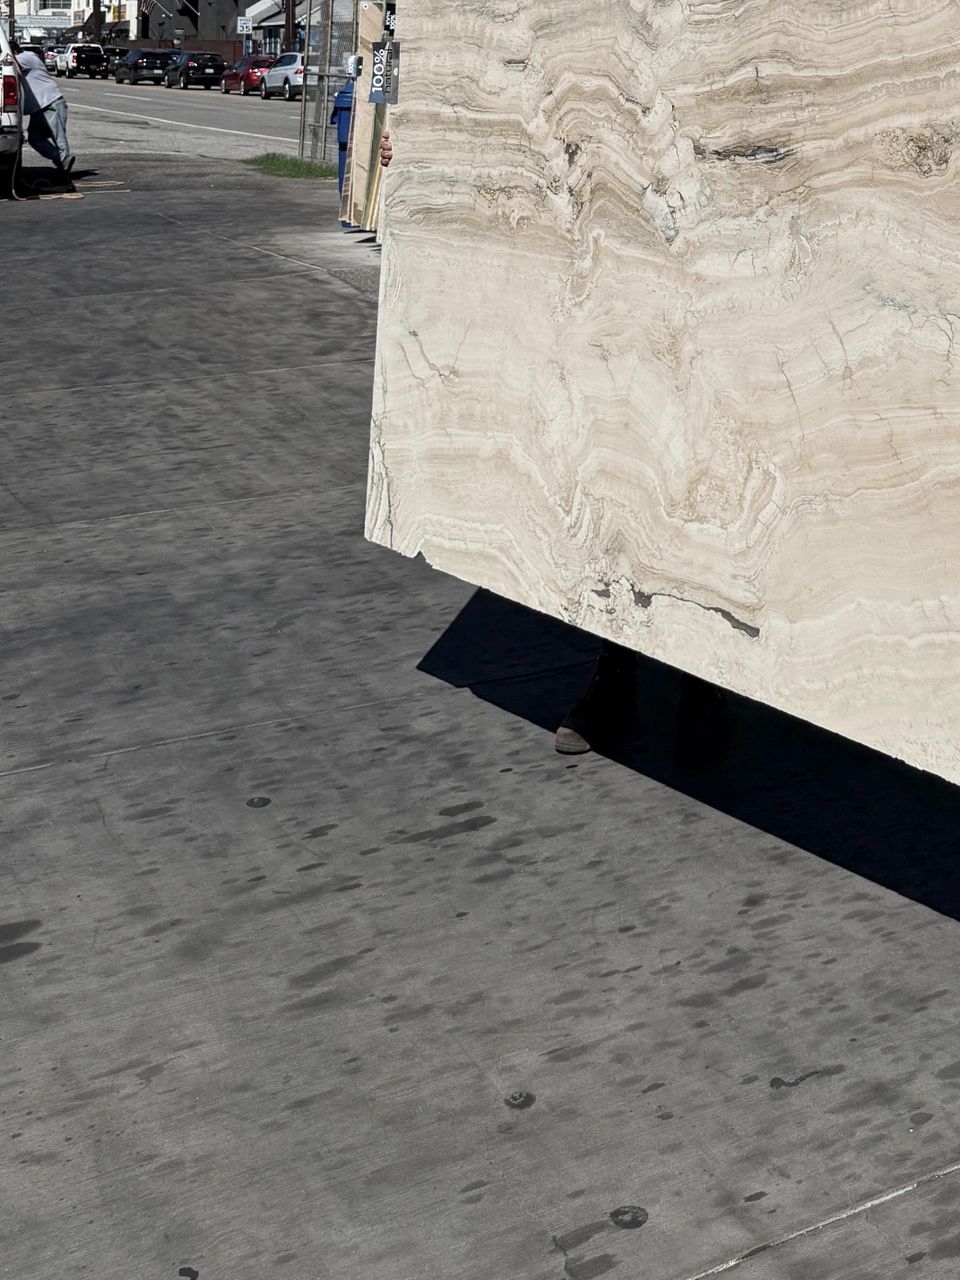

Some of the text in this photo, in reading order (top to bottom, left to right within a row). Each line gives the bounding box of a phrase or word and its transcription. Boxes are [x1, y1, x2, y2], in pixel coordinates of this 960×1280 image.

[239, 25, 251, 33] 35
[372, 48, 385, 93] 100%
[385, 48, 393, 94] natural
